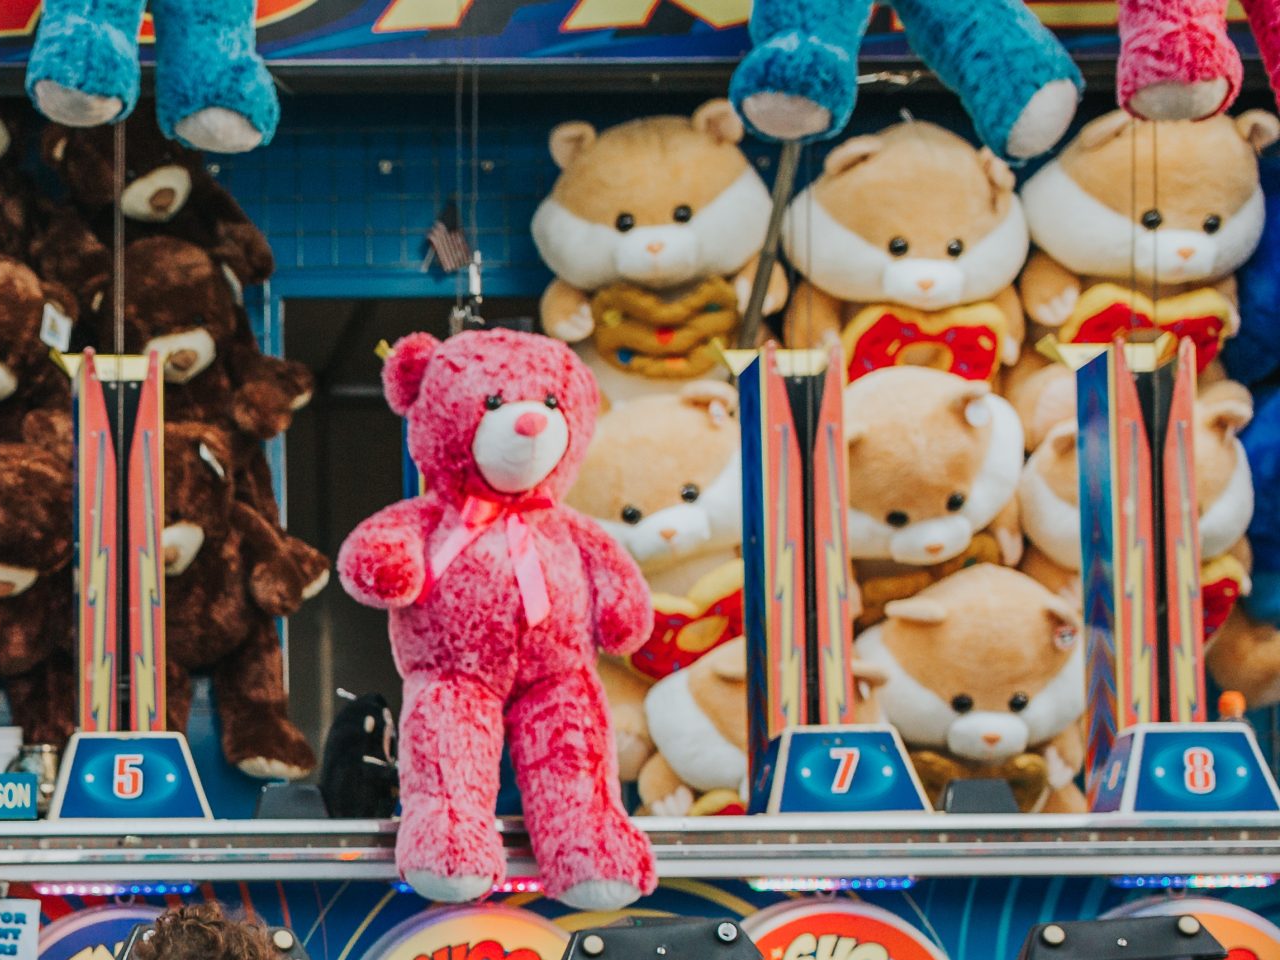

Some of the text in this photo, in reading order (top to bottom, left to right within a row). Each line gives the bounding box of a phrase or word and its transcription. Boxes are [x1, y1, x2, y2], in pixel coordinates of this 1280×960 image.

[112, 753, 144, 799] 5
[829, 747, 860, 793] 7
[1183, 746, 1216, 794] 8
